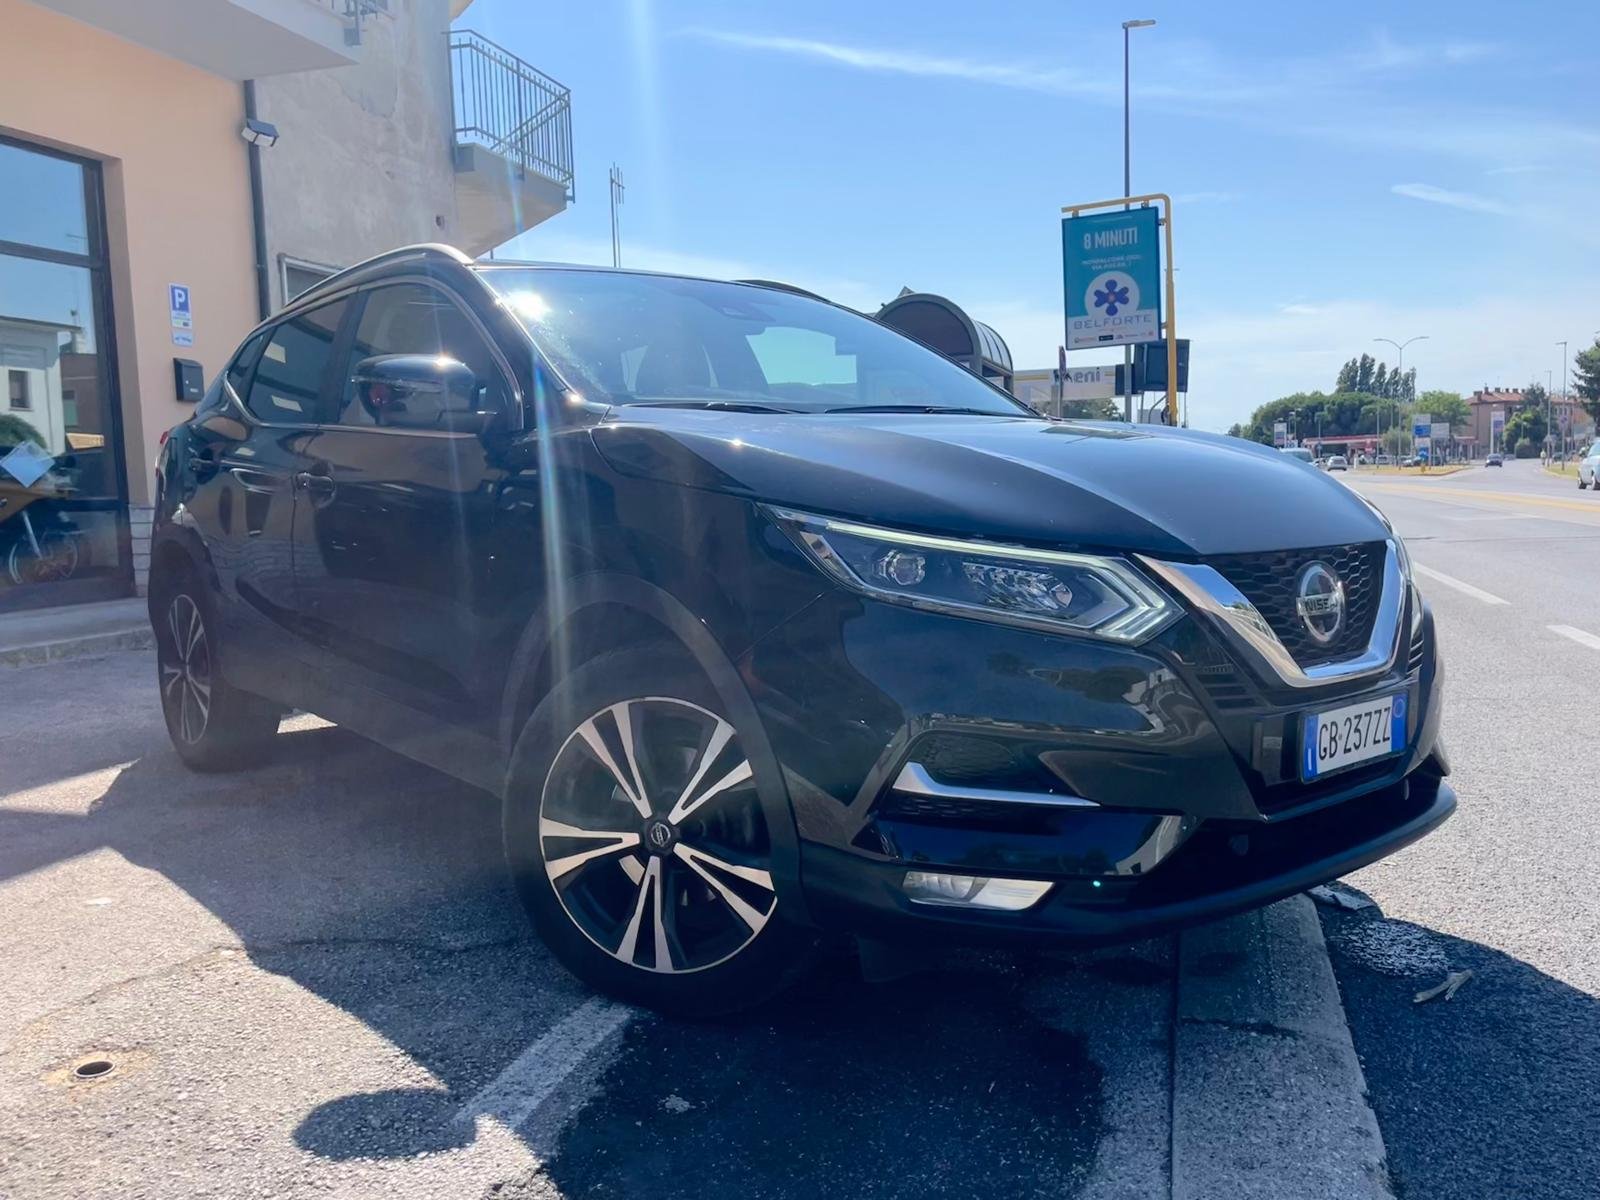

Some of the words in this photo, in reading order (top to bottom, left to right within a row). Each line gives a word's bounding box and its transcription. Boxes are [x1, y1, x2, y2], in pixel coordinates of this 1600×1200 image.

[1083, 232, 1092, 250] 8
[1094, 227, 1138, 249] MINUTI
[174, 287, 186, 308] P
[1073, 314, 1152, 330] BELFORTE
[1074, 366, 1102, 384] eni
